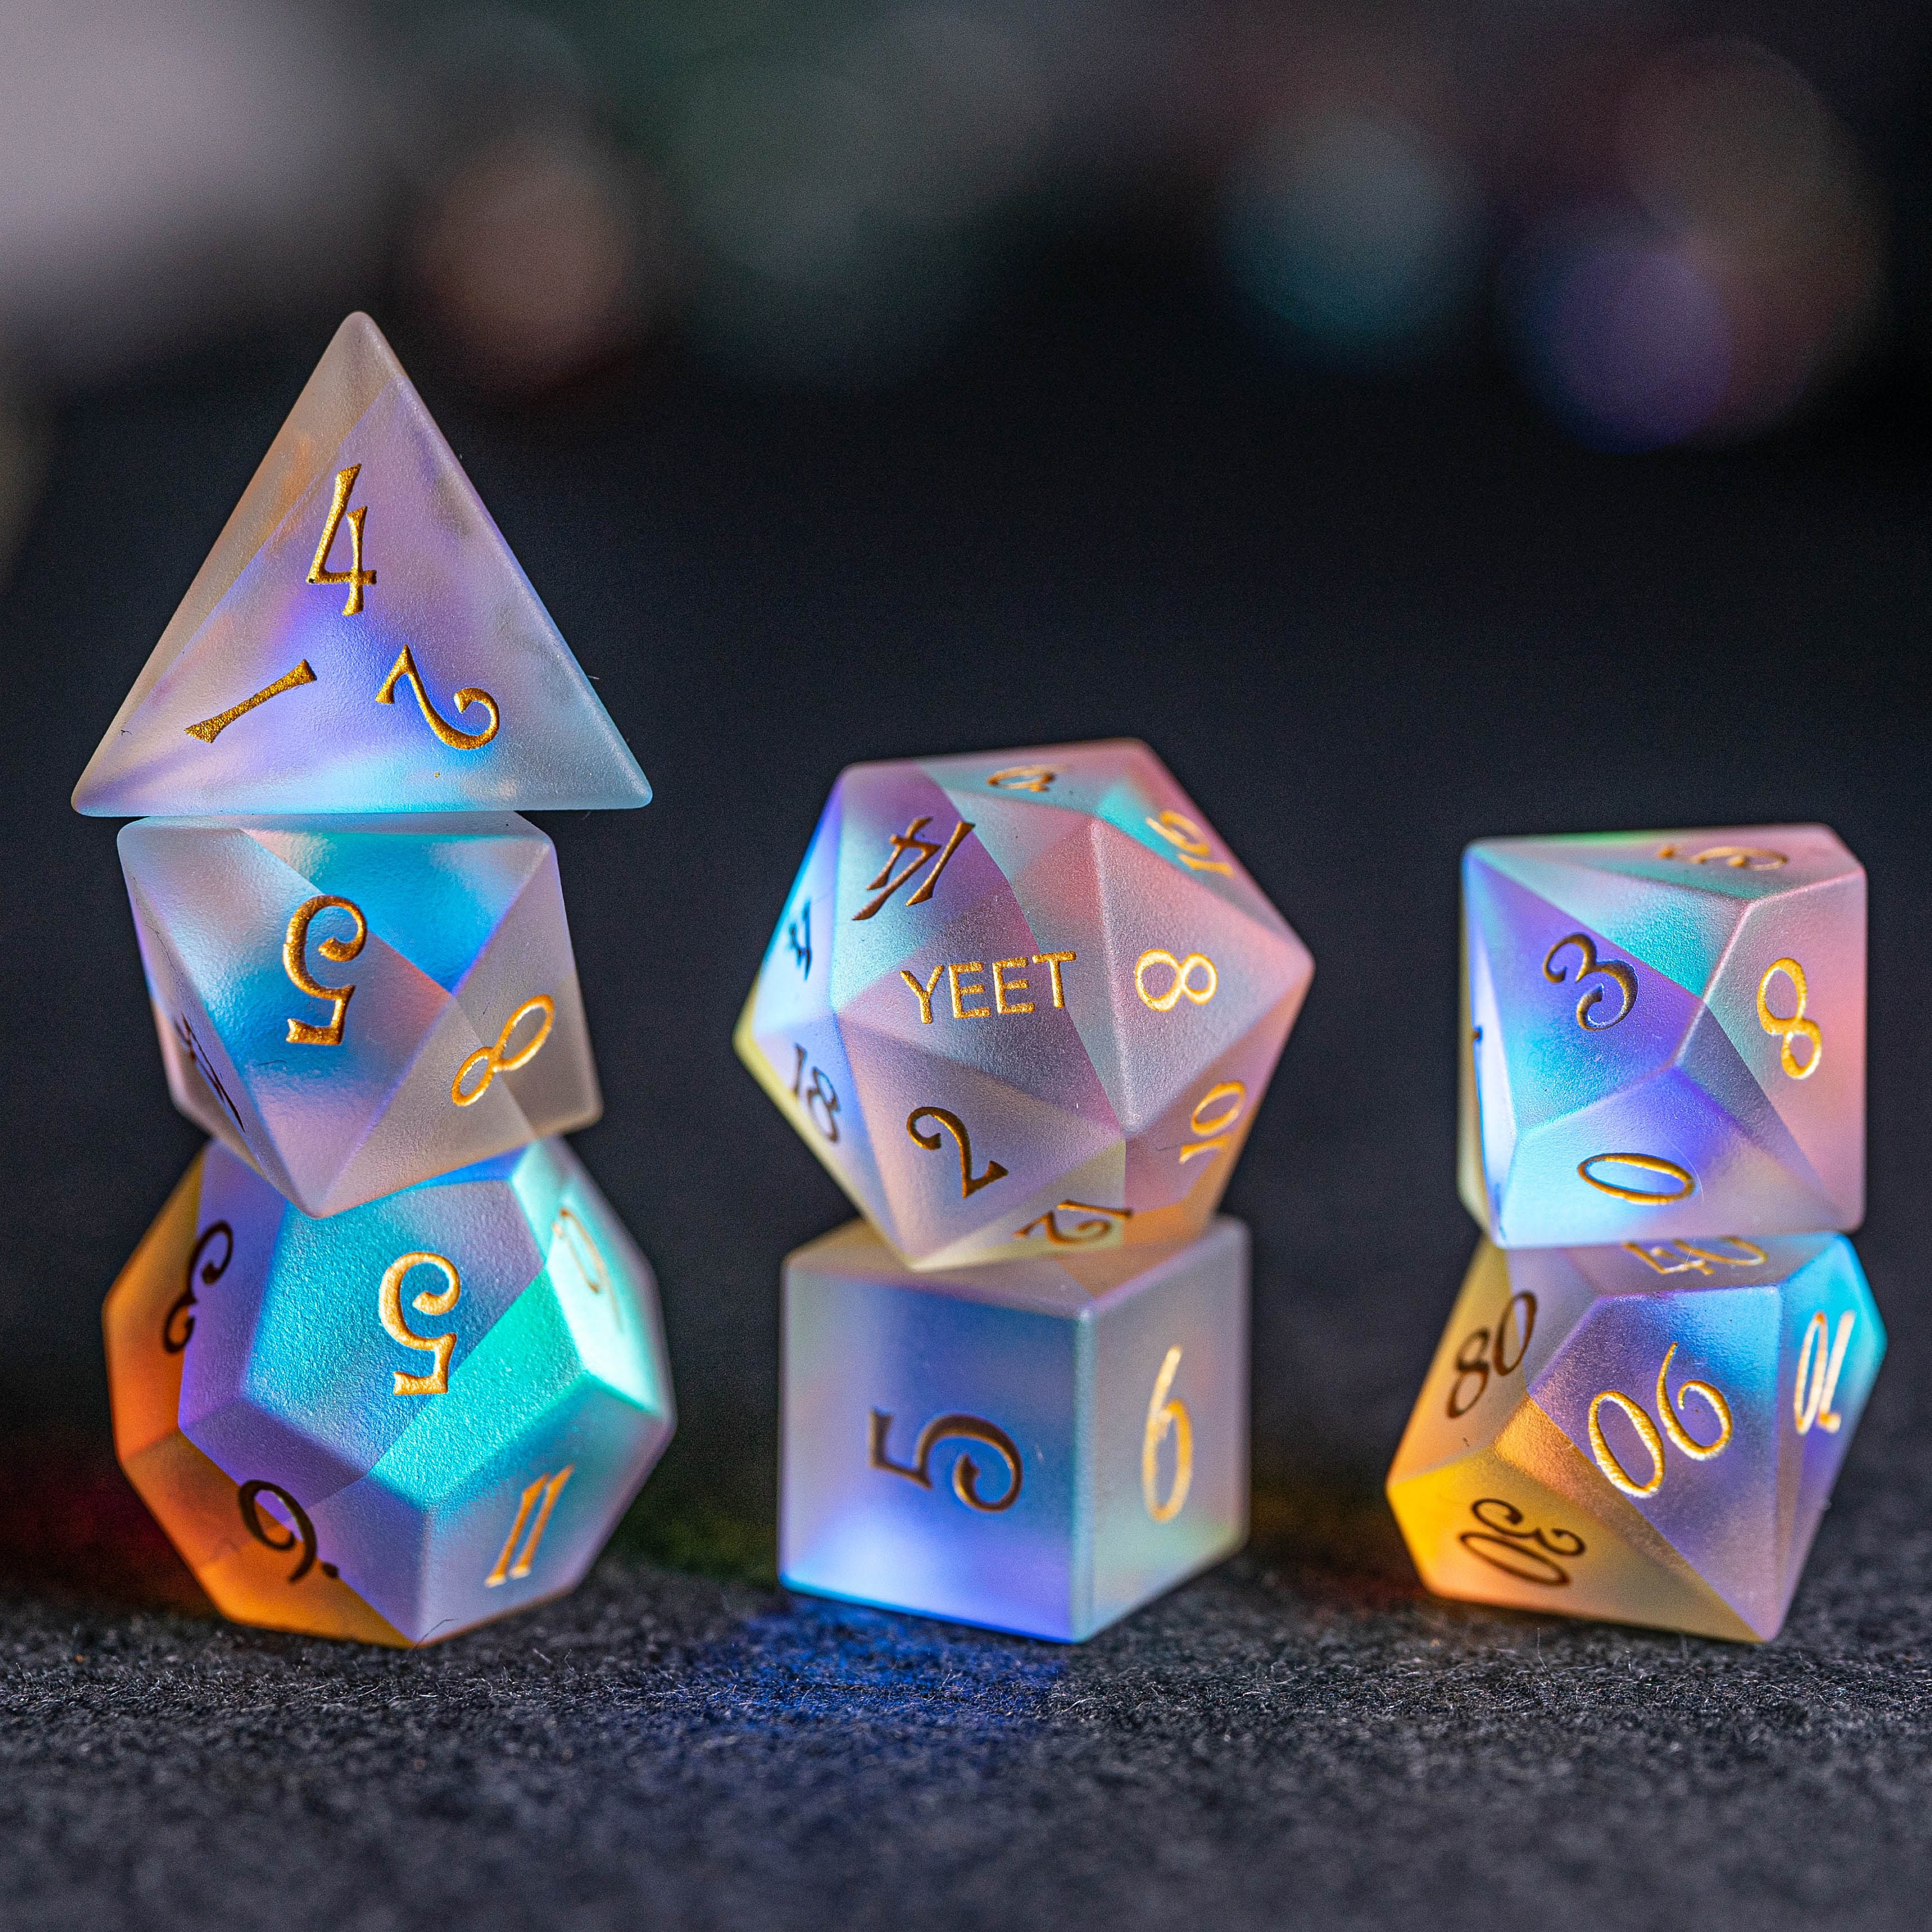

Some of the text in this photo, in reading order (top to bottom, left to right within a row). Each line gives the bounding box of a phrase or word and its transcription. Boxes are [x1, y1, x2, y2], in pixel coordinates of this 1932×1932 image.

[306, 463, 377, 616] 4
[184, 659, 317, 744] 1
[375, 645, 500, 750] 2
[852, 817, 976, 921] 14
[283, 895, 368, 1045] 5
[899, 951, 1077, 1024] YEET
[1134, 949, 1218, 1012] 8
[1543, 933, 1638, 1030] 3
[1757, 958, 1822, 1079] 8
[451, 994, 555, 1106] 8
[787, 1043, 840, 1144] 18
[906, 1106, 1009, 1198] 2
[1578, 1153, 1694, 1206] 0
[163, 1220, 233, 1353] 3
[378, 1251, 460, 1396] 5
[1446, 1291, 1537, 1418] 80
[868, 1406, 1023, 1512] 5
[1142, 1345, 1193, 1522] 6
[485, 1465, 575, 1587] 11
[1460, 1498, 1585, 1587] 30
